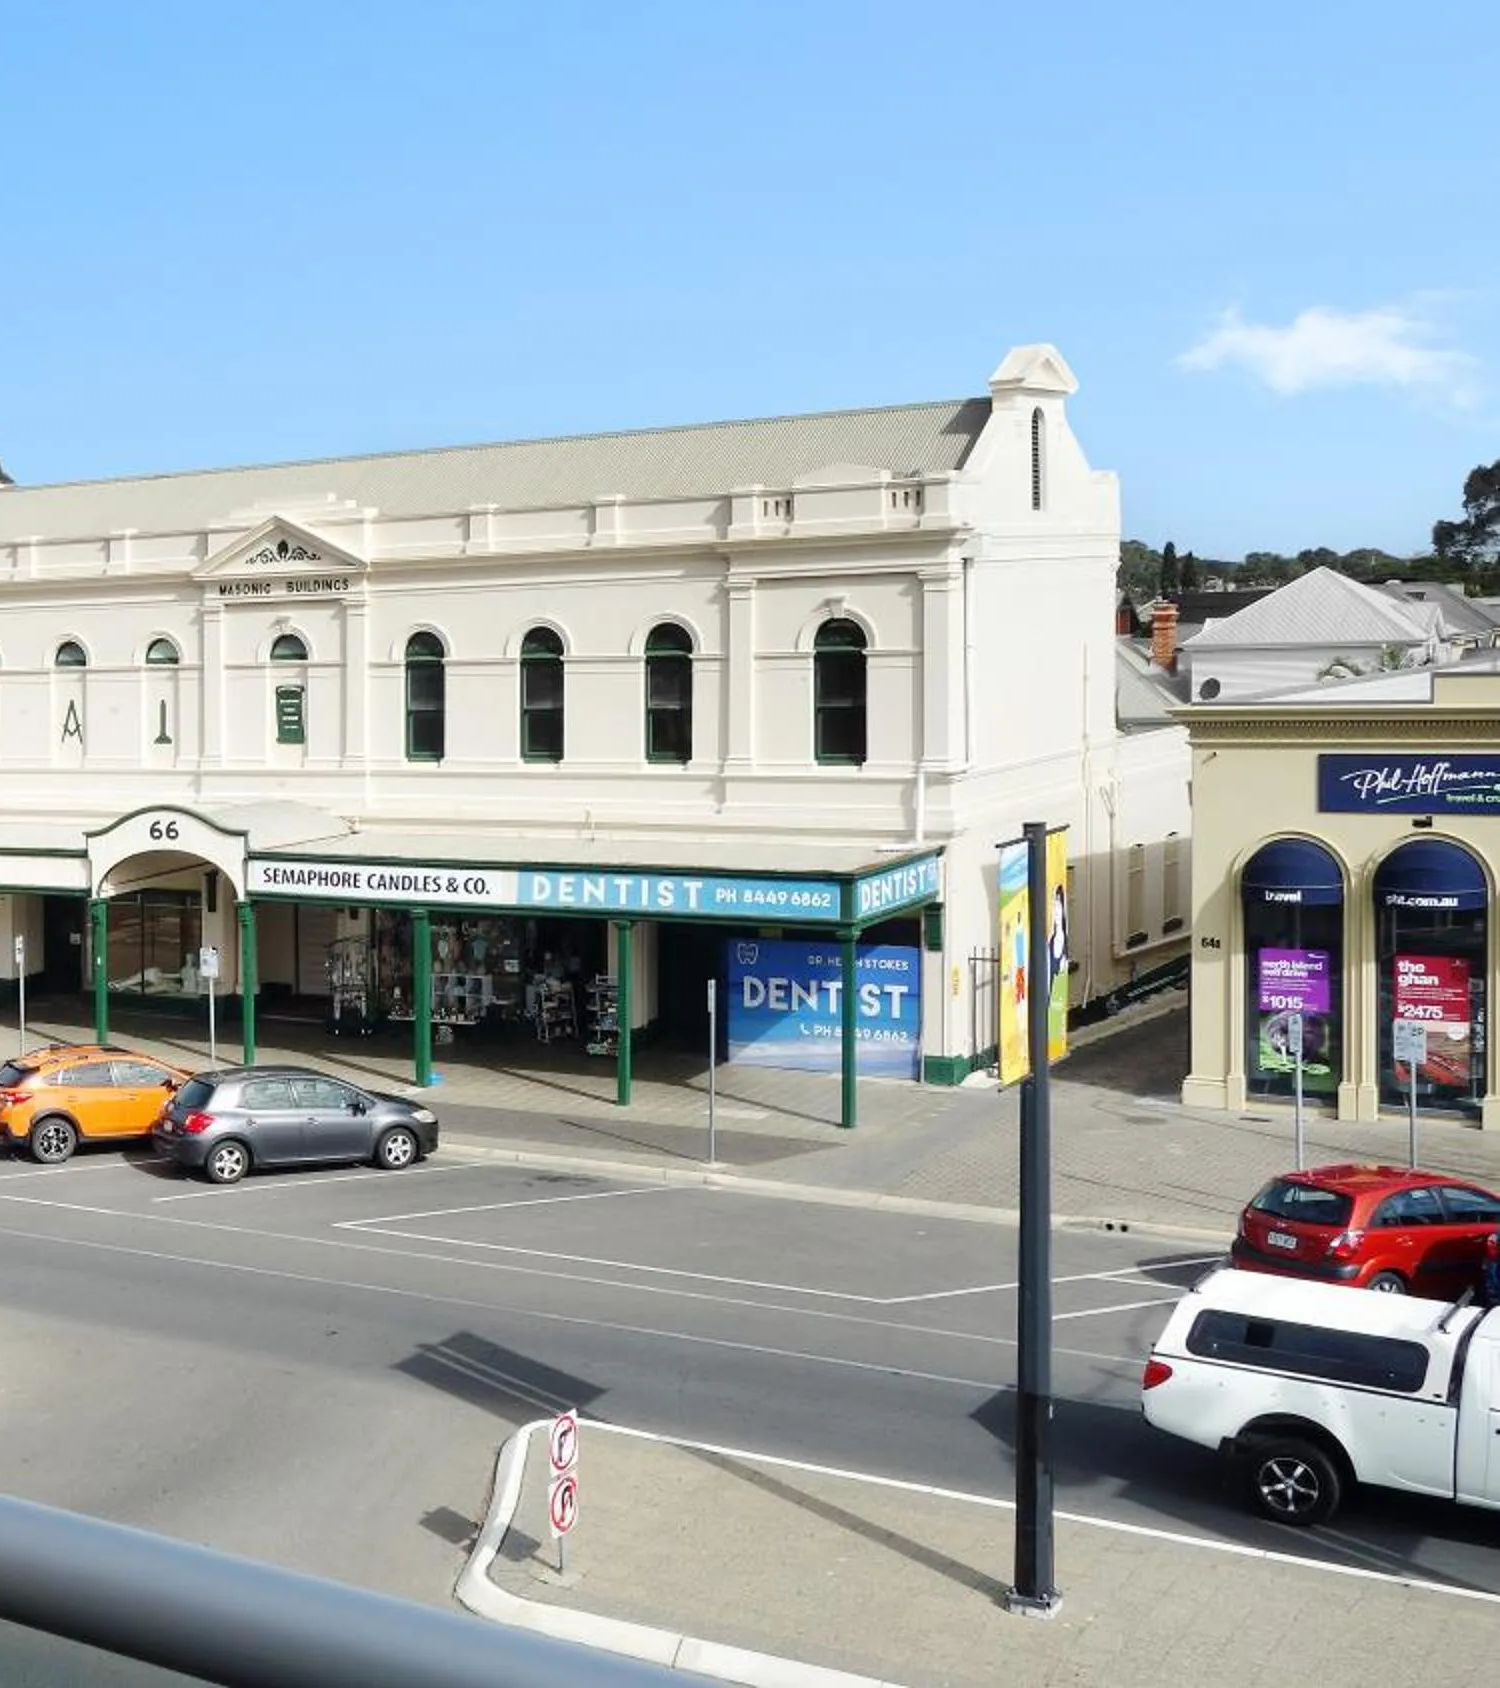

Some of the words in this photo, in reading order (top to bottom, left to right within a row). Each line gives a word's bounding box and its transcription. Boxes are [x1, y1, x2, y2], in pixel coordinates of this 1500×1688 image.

[219, 583, 271, 596] MASONIC
[286, 578, 349, 593] BUILDINGS
[1340, 766, 1401, 799] Phil
[150, 820, 179, 840] 66
[263, 867, 361, 889] SEMAPHORE
[367, 873, 441, 893] CANDLES
[445, 877, 458, 893] &
[463, 877, 490, 895] CO.
[861, 863, 927, 912] DENTIST
[532, 875, 703, 909] DENTIST
[715, 887, 737, 903] PH
[743, 889, 787, 904] 8449
[791, 891, 832, 907] 6862
[864, 958, 909, 971] STOKES
[1398, 960, 1425, 973] the
[1398, 972, 1439, 987] ghan
[743, 975, 909, 1019] DENTST
[813, 1023, 831, 1037] PH
[834, 1025, 871, 1039] 849
